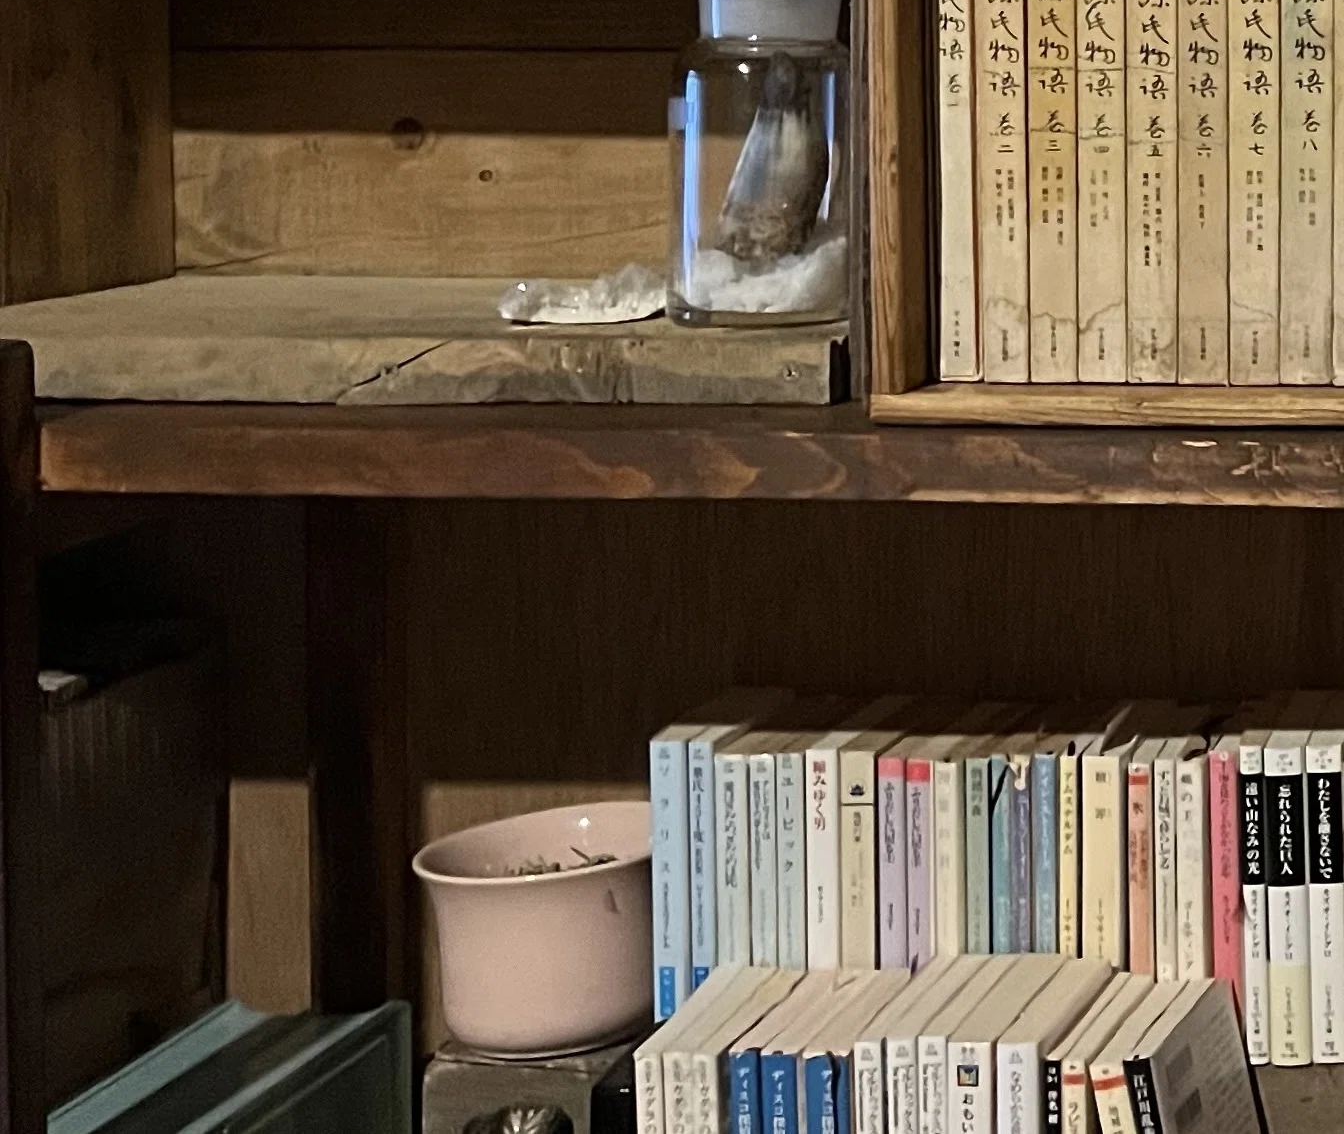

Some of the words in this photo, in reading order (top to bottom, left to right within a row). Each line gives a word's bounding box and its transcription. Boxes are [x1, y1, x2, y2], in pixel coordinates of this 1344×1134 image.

[945, 73, 961, 110] 巻一
[991, 111, 1013, 154] 巻二
[1042, 107, 1065, 153] 巻三
[1091, 112, 1113, 153] 巻四
[1144, 112, 1166, 159] 巻五
[1194, 112, 1215, 159] 巻六
[1248, 112, 1267, 157] 巻七
[1300, 111, 1321, 153] 巻八
[658, 765, 671, 873] ソラリス
[781, 777, 794, 872] ユービック
[1063, 772, 1073, 854] アムステルダム
[1245, 782, 1261, 875] 遠い山なみの光
[1278, 784, 1293, 875] 忘れられた巨人
[1317, 778, 1333, 878] わたしを離さないで
